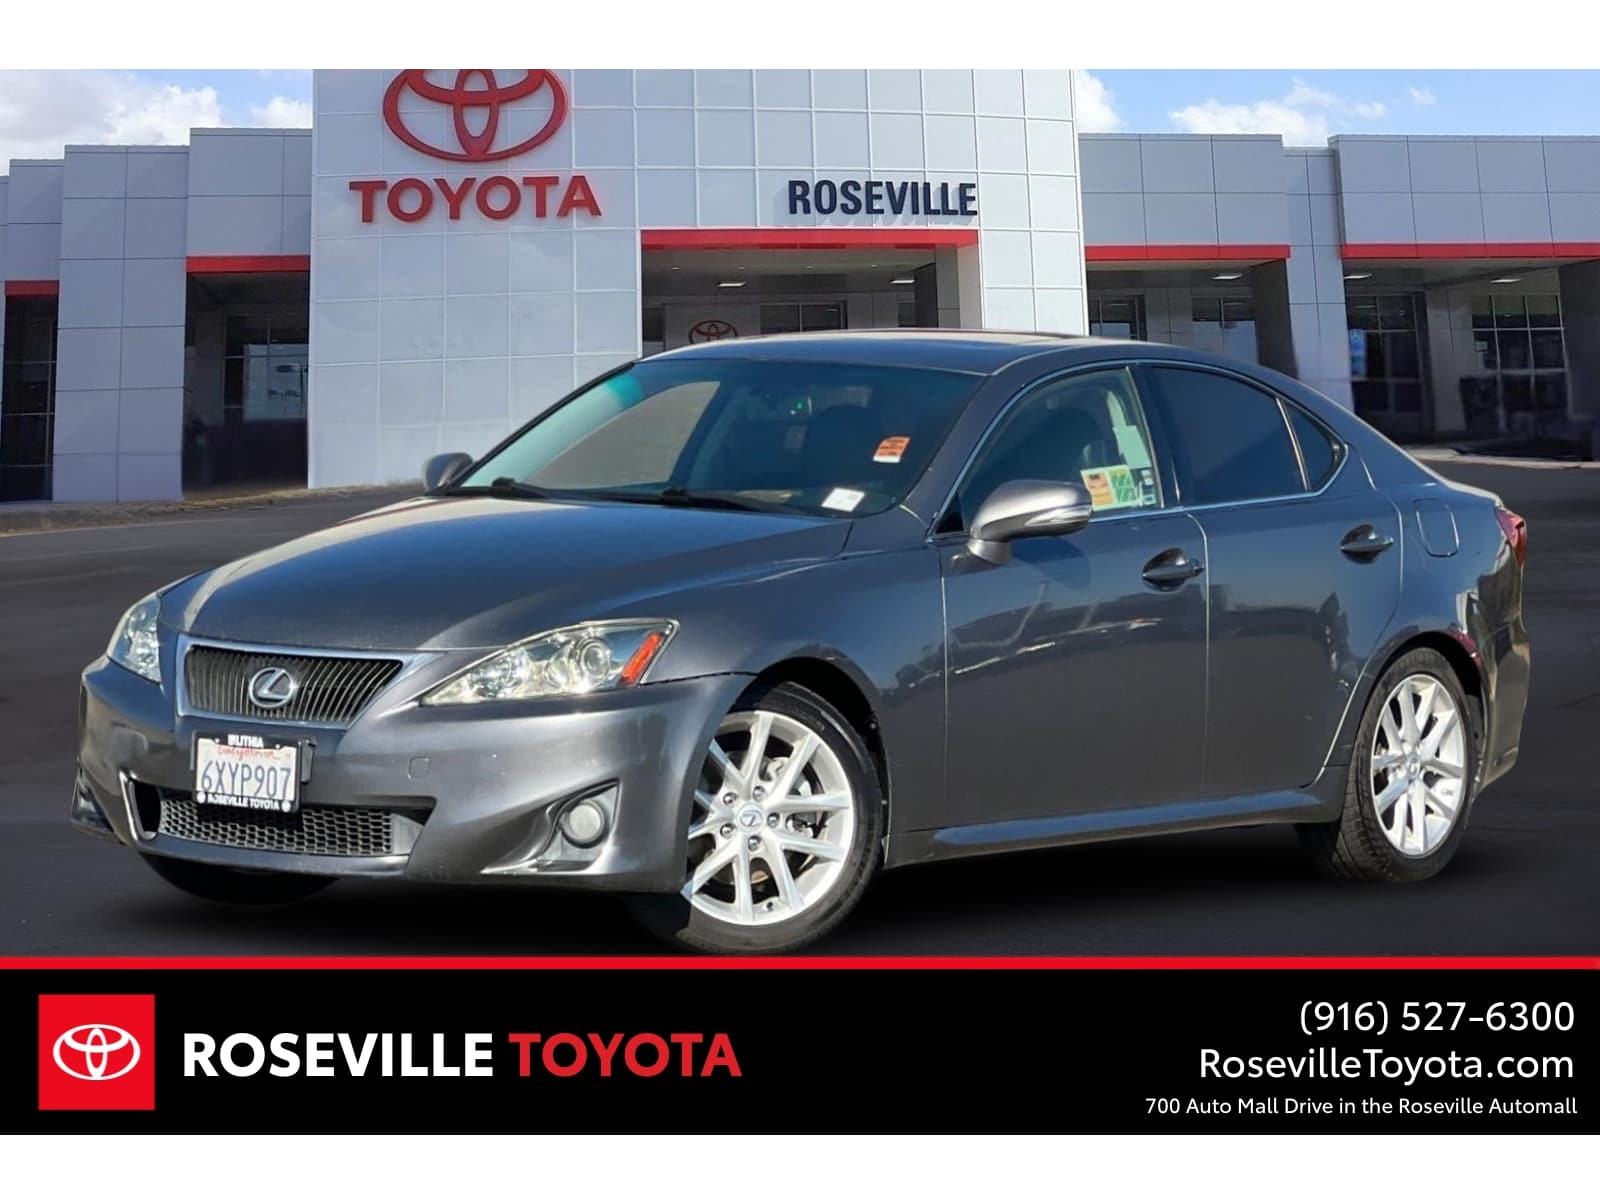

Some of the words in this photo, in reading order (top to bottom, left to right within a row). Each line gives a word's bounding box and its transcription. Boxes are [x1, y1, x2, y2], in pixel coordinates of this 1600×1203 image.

[349, 175, 602, 223] TOYOTA
[788, 179, 978, 216] ROSEVILLE
[201, 760, 292, 801] 6XYP907
[249, 797, 280, 811] TOYOTA
